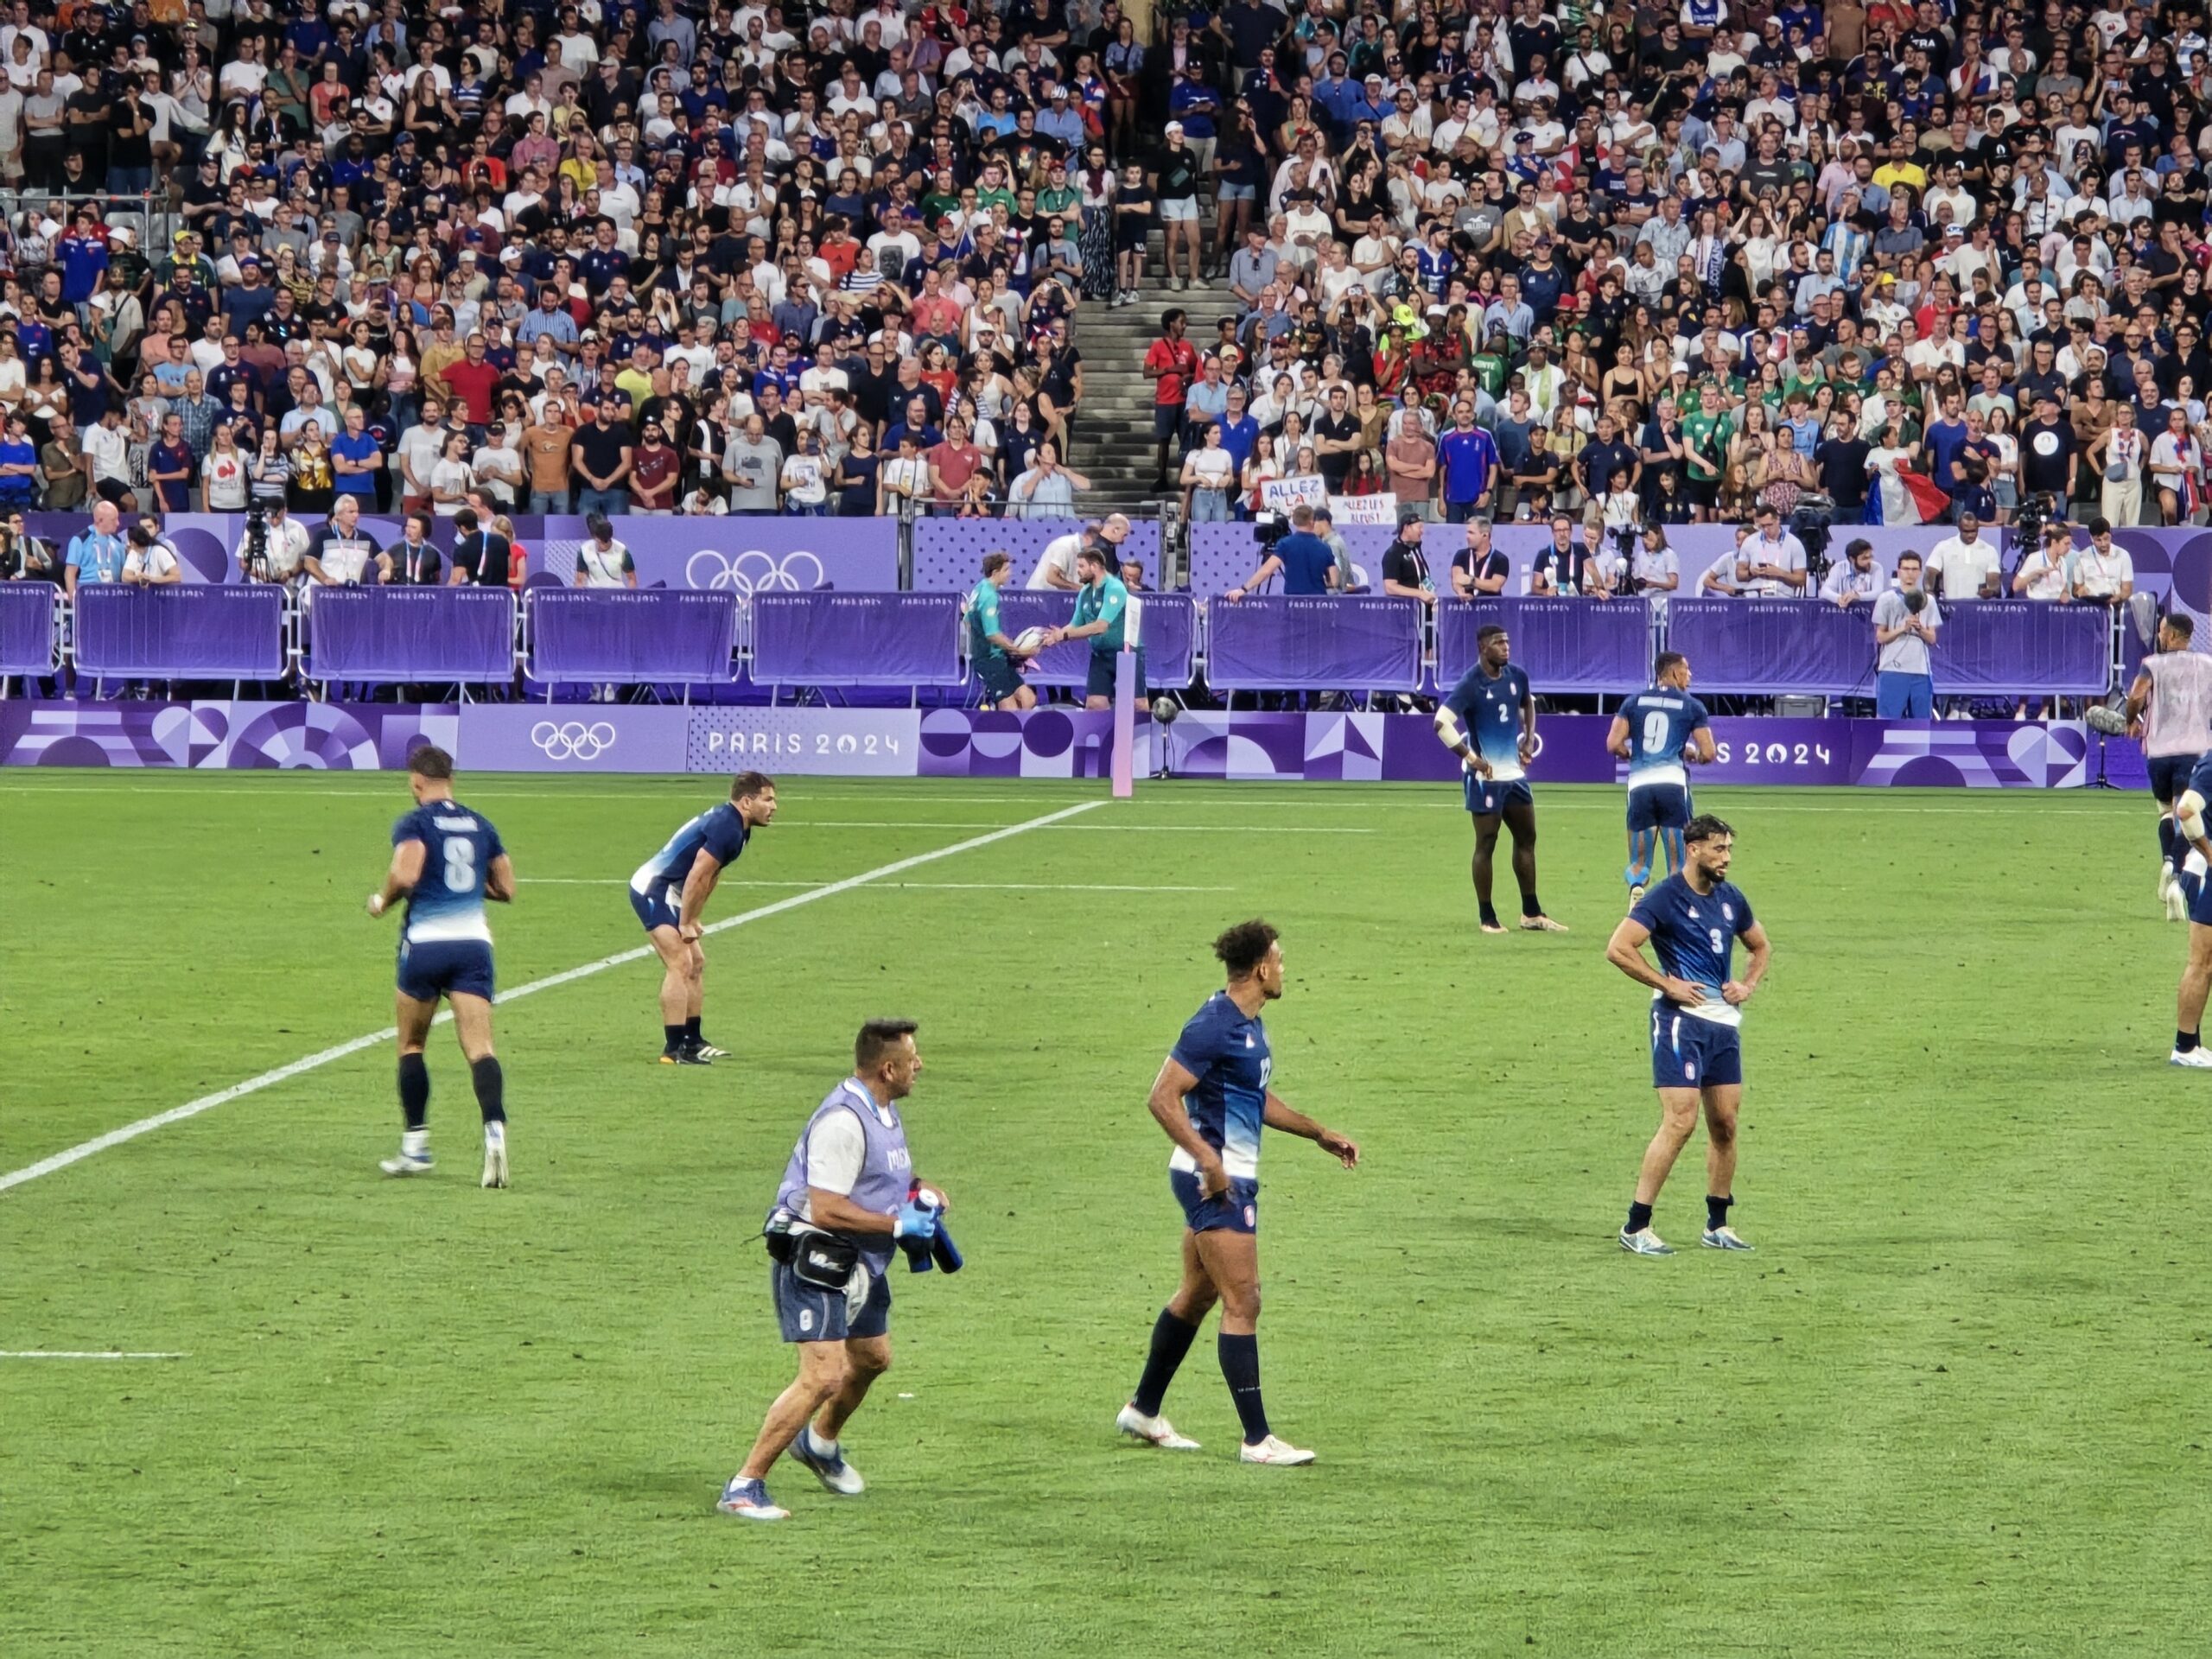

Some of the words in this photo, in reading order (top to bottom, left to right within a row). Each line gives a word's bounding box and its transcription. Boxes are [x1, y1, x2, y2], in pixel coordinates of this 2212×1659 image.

[1268, 479, 1319, 499] ALLEZ
[1285, 493, 1306, 507] LA
[1497, 702, 1510, 723] 2
[709, 731, 802, 754] PARIS
[815, 733, 899, 756] 2024
[1642, 710, 1669, 755] 9
[1745, 741, 1831, 766] 2024
[442, 836, 476, 893] 8
[1709, 927, 1725, 955] 3
